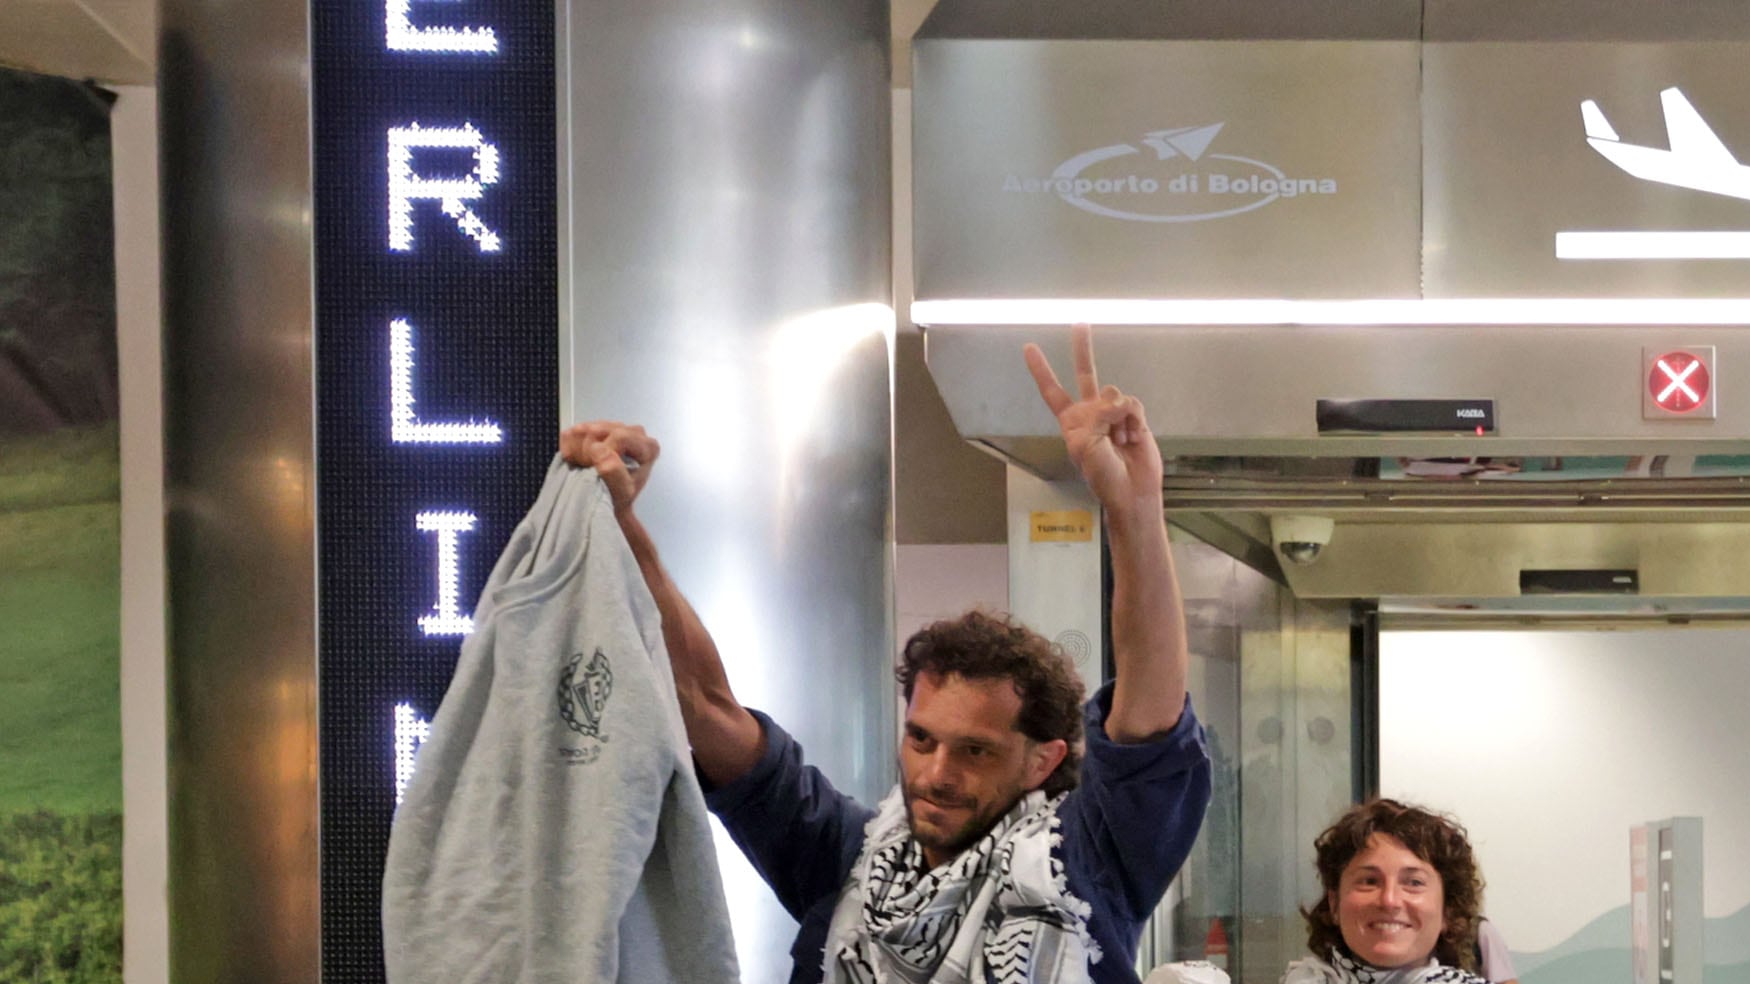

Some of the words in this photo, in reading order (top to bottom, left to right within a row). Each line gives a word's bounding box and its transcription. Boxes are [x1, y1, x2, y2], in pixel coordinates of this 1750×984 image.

[1002, 175, 1160, 196] Aeroporto
[1169, 173, 1198, 193] di
[1208, 173, 1337, 197] Bologna
